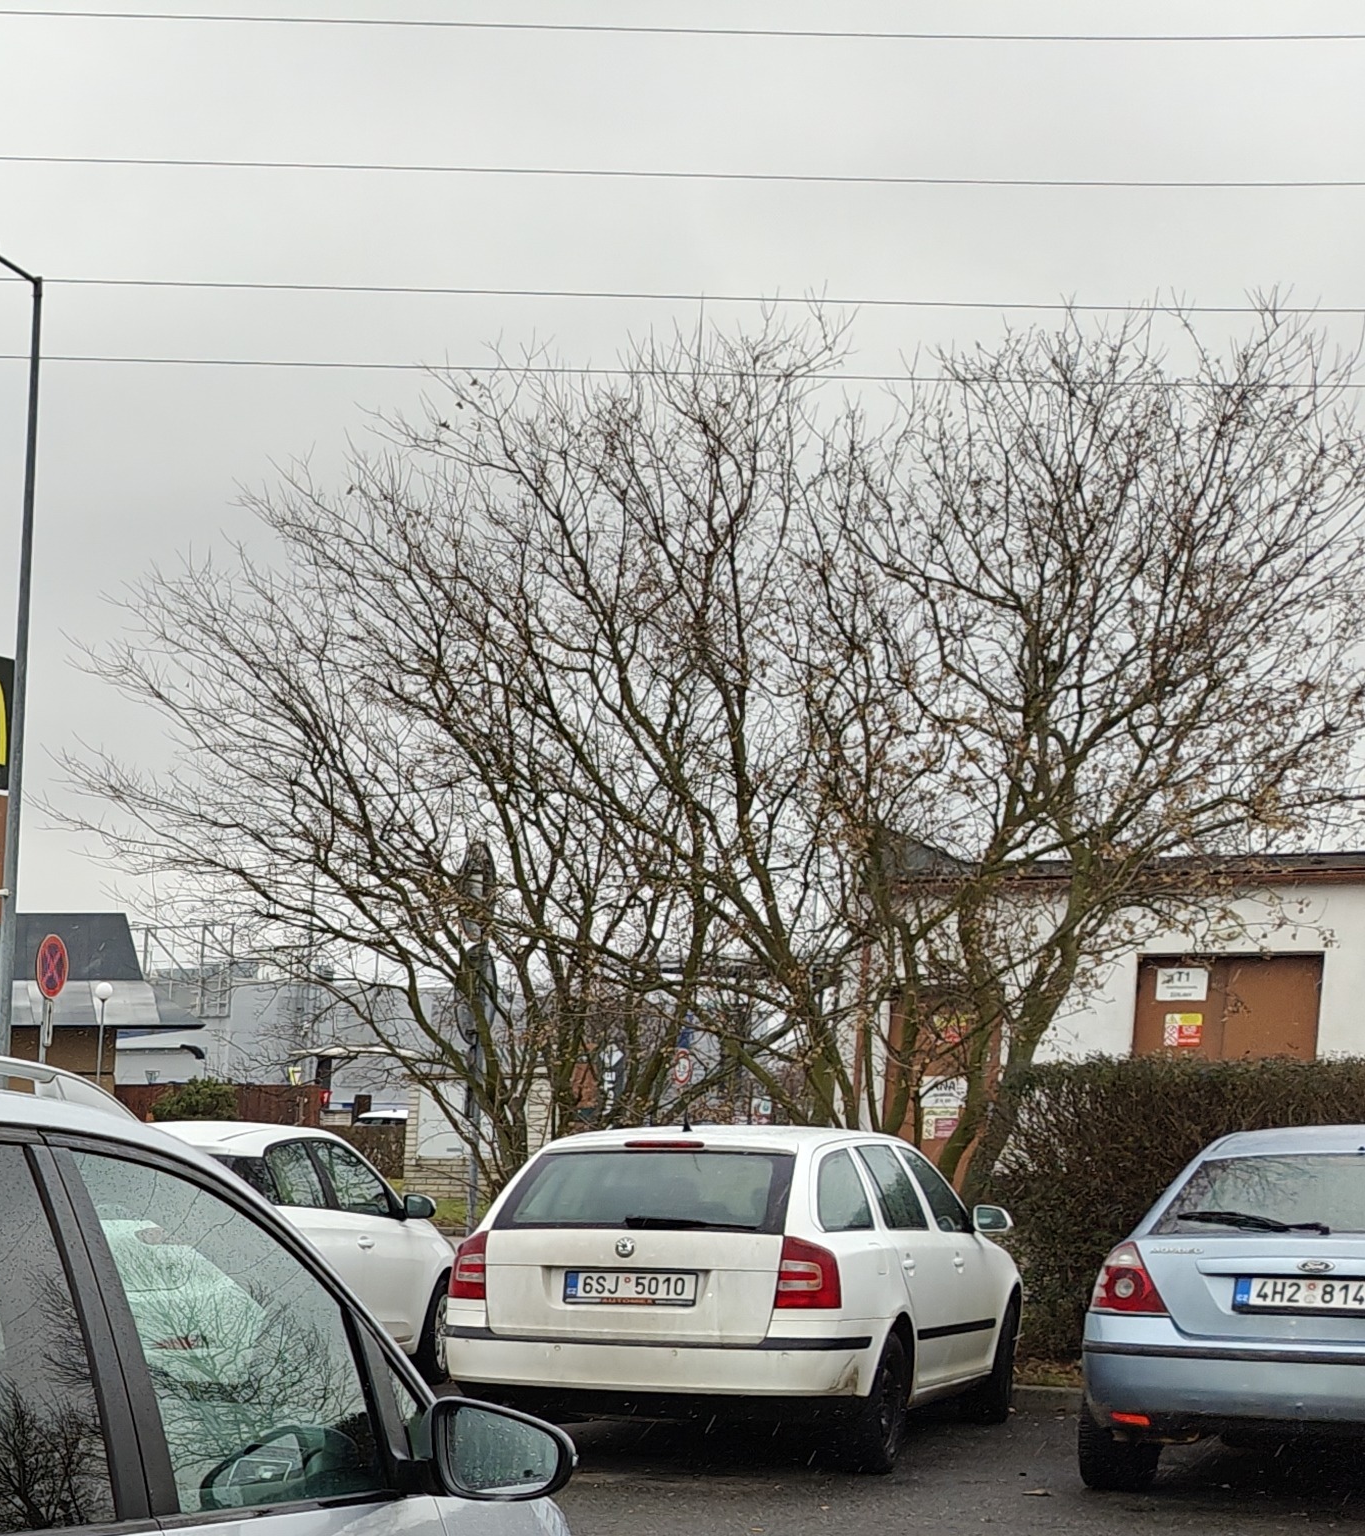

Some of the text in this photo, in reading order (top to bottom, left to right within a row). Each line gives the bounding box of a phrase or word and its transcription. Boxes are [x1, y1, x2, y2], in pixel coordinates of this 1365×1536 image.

[582, 1276, 619, 1294] 6SJ
[635, 1276, 685, 1296] 5010
[1256, 1281, 1300, 1303] 4H2
[1321, 1283, 1365, 1304] 814
